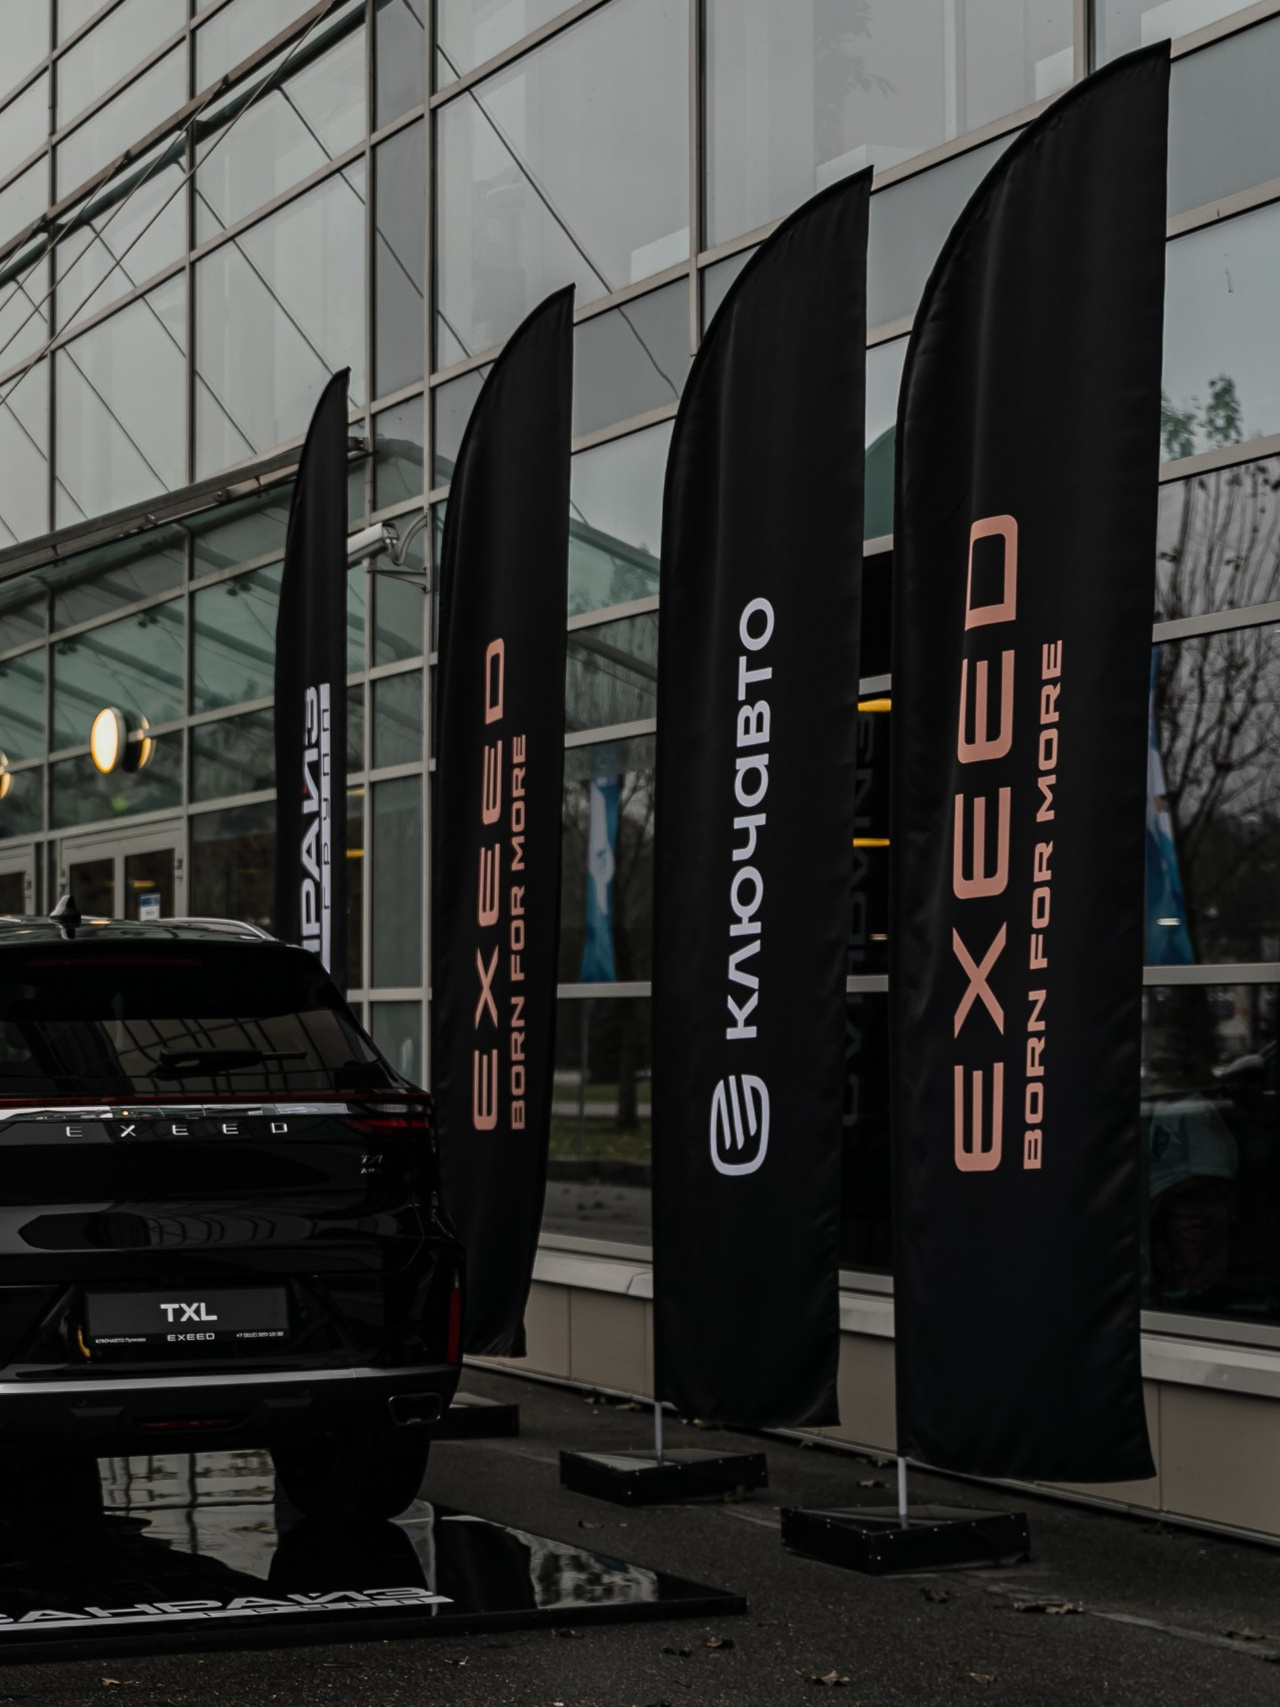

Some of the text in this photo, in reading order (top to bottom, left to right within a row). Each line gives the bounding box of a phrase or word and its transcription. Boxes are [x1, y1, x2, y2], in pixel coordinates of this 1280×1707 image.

[472, 637, 506, 1132] EXEED
[510, 734, 527, 1130] BORN FOR MORE
[952, 514, 1019, 1172] EXEED
[1023, 640, 1063, 1170] BORN FOR MORE
[65, 1122, 288, 1138] EXEED
[160, 1303, 218, 1323] TXL
[166, 1332, 216, 1342] EXEED
